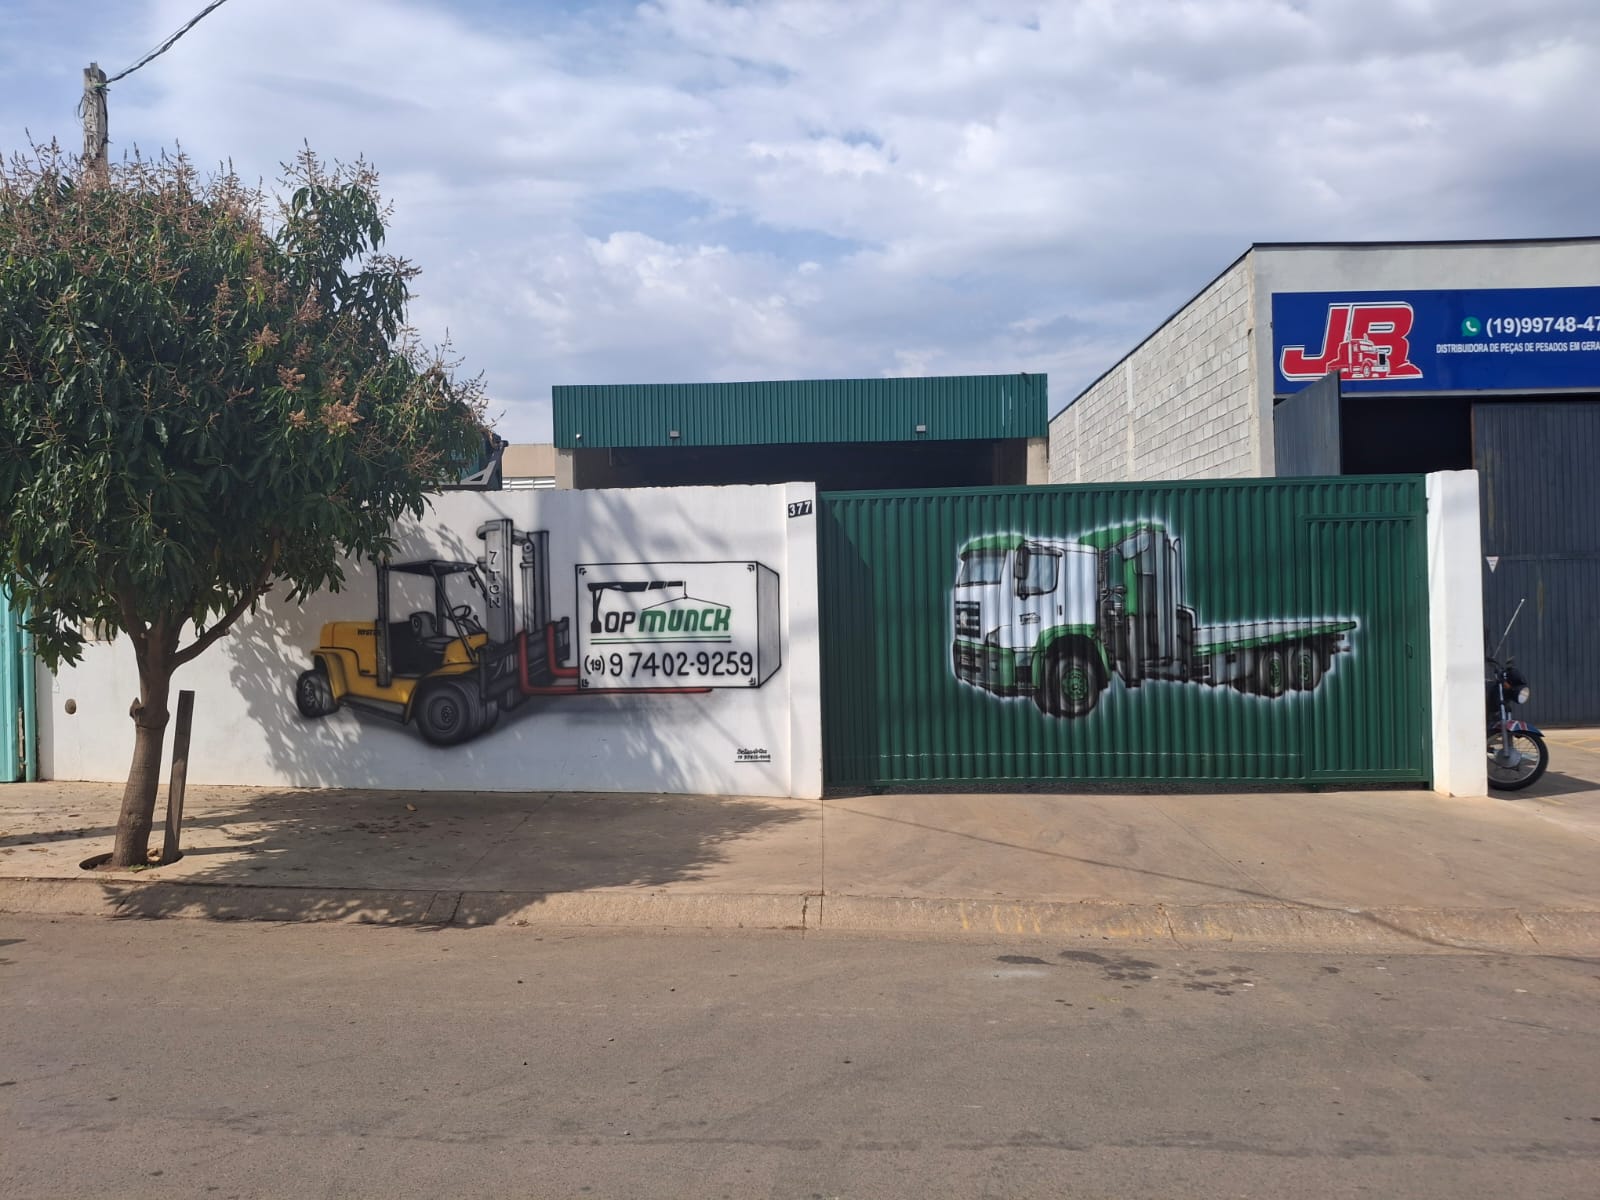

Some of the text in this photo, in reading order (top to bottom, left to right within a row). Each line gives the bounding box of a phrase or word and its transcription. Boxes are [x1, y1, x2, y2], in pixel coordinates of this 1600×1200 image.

[1280, 301, 1423, 381] JB
[1436, 343, 1488, 354] DISTRIBUIDORA
[1489, 343, 1500, 353] DE
[1500, 343, 1524, 354] PEÇAS
[1524, 342, 1535, 352] DE
[1535, 342, 1568, 352] PESADOS
[1569, 341, 1580, 351] EM
[789, 501, 811, 517] 377
[489, 550, 498, 565] 7
[584, 655, 606, 675] (19)
[610, 652, 623, 677] 9
